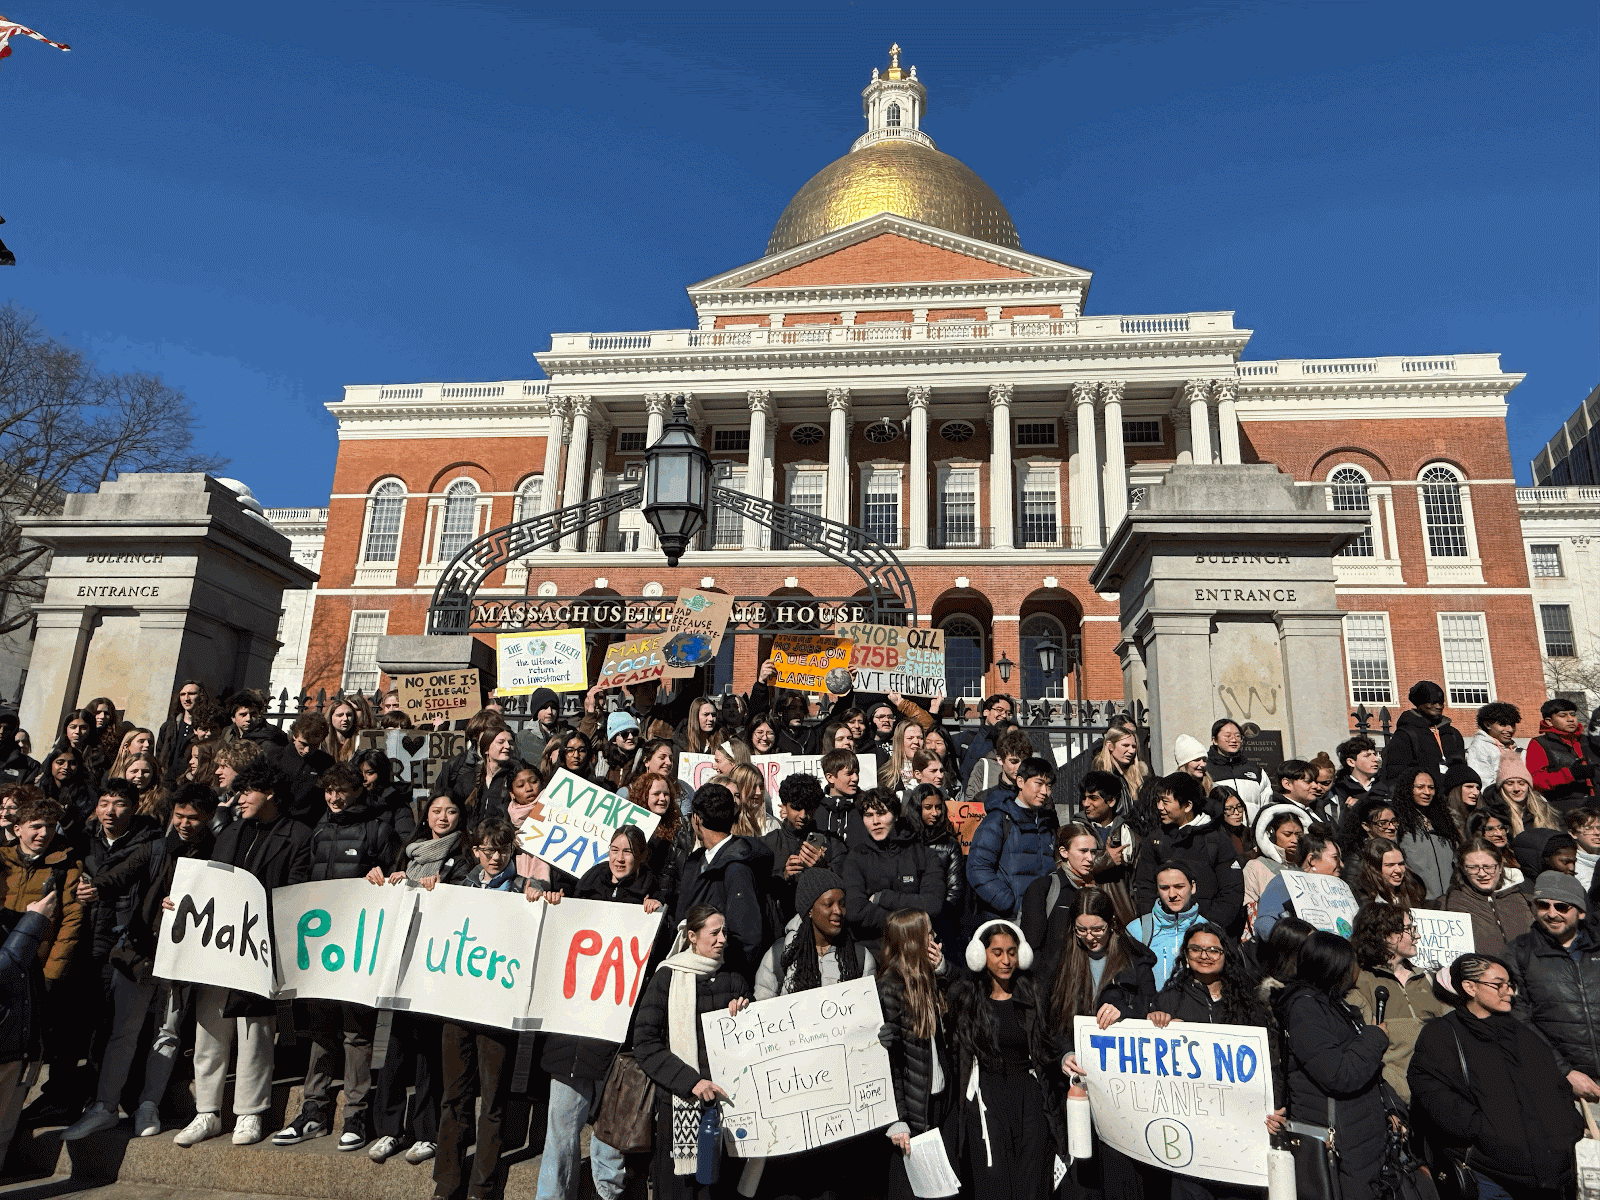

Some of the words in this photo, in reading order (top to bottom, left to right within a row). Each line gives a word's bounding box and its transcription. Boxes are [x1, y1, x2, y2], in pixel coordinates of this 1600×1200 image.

[86, 553, 164, 564] BULFINCH
[1194, 551, 1291, 564] BULFINCH
[77, 585, 160, 597] ENTRANCE
[1195, 588, 1297, 602] ENTRANCE
[476, 605, 672, 623] MASSACHUSETT
[729, 606, 767, 623] ATE
[776, 606, 865, 623] HOUSE
[676, 607, 692, 616] SAD
[671, 624, 681, 632] OF
[672, 615, 712, 630] BECAUSE
[607, 636, 664, 659] MAKE
[907, 629, 940, 651] OIL
[504, 643, 523, 655] THE
[554, 641, 581, 660] EARTH
[825, 647, 846, 660] ON
[906, 648, 944, 664] CLEAN
[516, 658, 530, 667] the
[602, 652, 661, 676] COOL
[774, 652, 784, 664] A
[787, 653, 830, 669] DEAD
[528, 666, 555, 674] return
[600, 665, 665, 687] AGAIN
[405, 677, 424, 689] NO
[429, 674, 456, 686] ONE
[460, 673, 477, 686] IS
[512, 677, 525, 686] on
[407, 698, 422, 709] ON
[424, 697, 467, 709] STOLEN
[413, 710, 450, 723] LAND!
[428, 732, 466, 759] BIG
[548, 776, 651, 830] MAKE
[539, 825, 610, 873] PAY
[1296, 875, 1320, 894] The
[171, 893, 269, 968] Make
[296, 907, 385, 974] Poll
[426, 916, 521, 990] uters
[563, 929, 653, 1008] PAY
[717, 1010, 796, 1050] Protect
[820, 999, 855, 1020] Our
[755, 1041, 781, 1056] Time
[798, 1032, 830, 1044] Running
[831, 1025, 848, 1038] Out
[1089, 1034, 1201, 1080] THERE'S
[1213, 1042, 1258, 1084] NO
[766, 1066, 833, 1101] Future
[859, 1086, 882, 1102] Home
[1107, 1077, 1233, 1117] PLANET
[824, 1119, 845, 1137] Air
[1162, 1124, 1182, 1160] B
